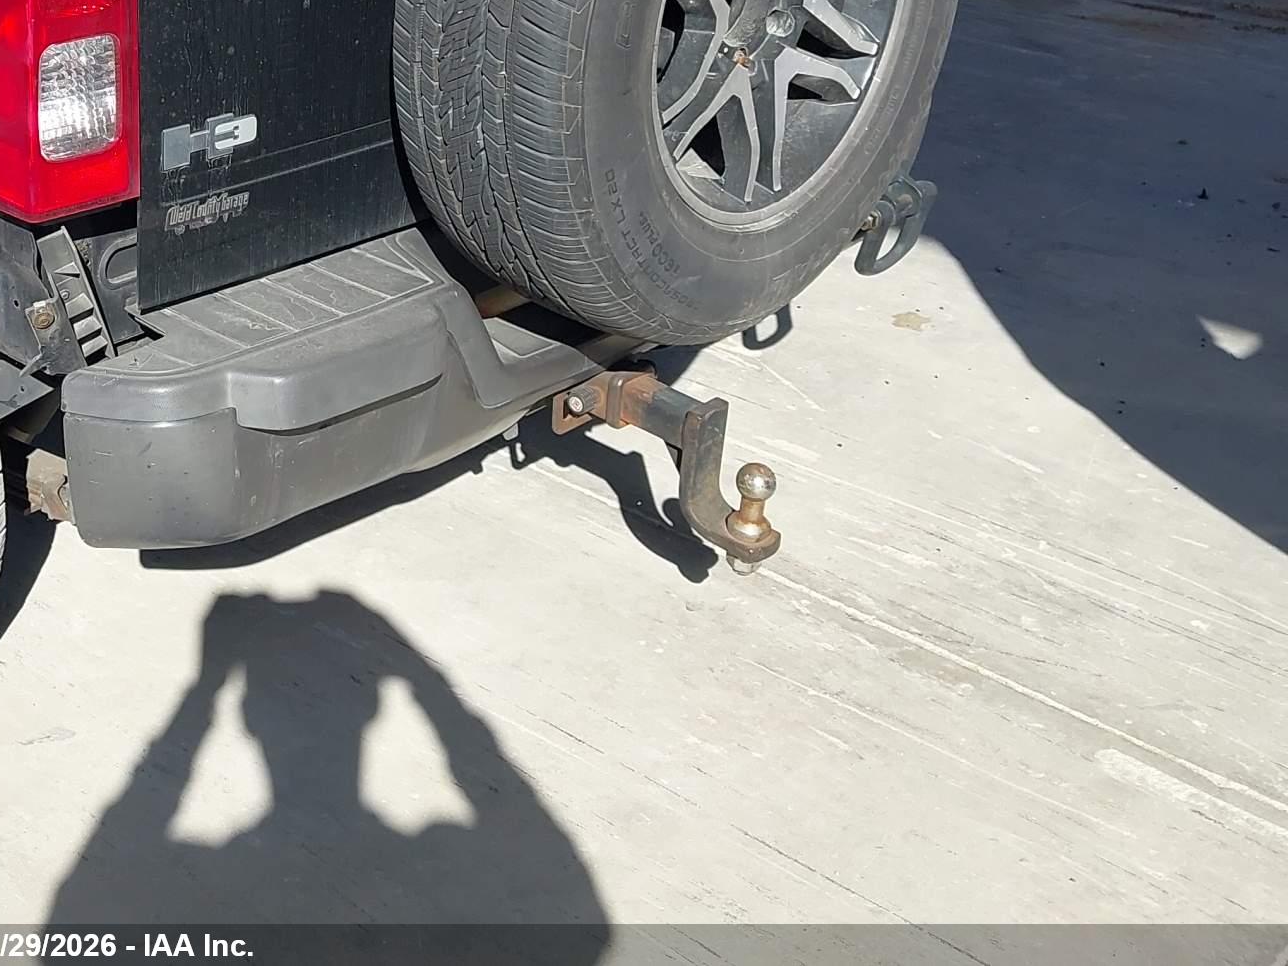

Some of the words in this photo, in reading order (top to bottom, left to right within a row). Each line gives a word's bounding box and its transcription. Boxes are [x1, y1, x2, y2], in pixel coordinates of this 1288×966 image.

[159, 111, 258, 173] H3
[604, 168, 619, 197] 20
[610, 200, 627, 225] LX
